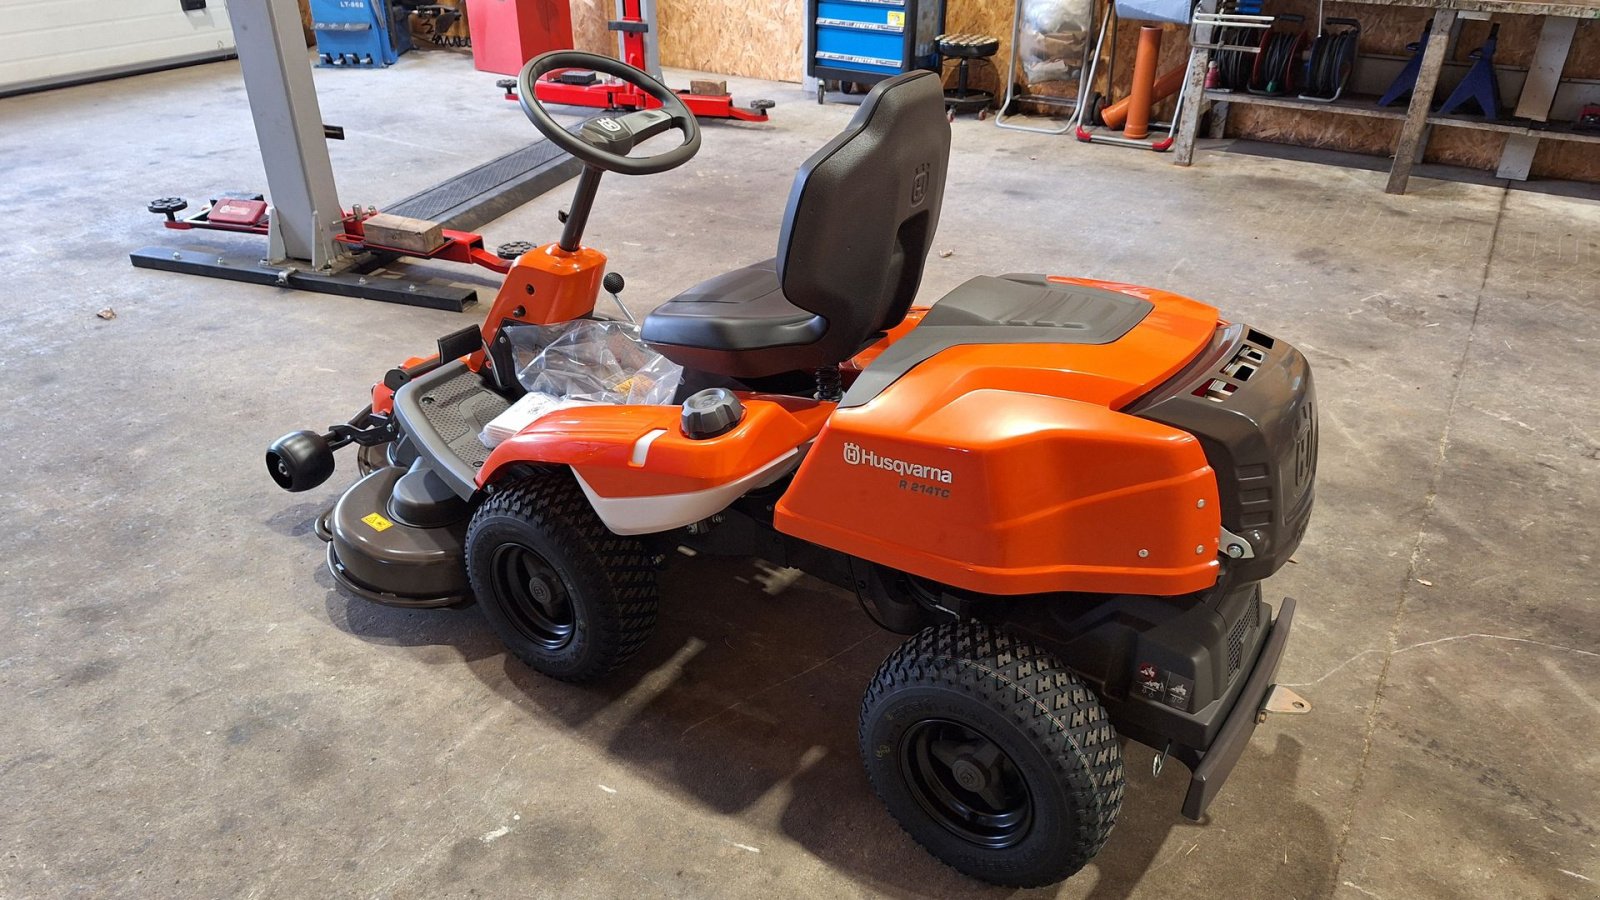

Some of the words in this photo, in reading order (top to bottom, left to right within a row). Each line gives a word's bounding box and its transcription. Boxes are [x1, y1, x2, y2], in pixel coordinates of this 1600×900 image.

[861, 449, 952, 483] Husqvarna
[899, 480, 907, 490] R
[911, 483, 950, 498] 214TC
